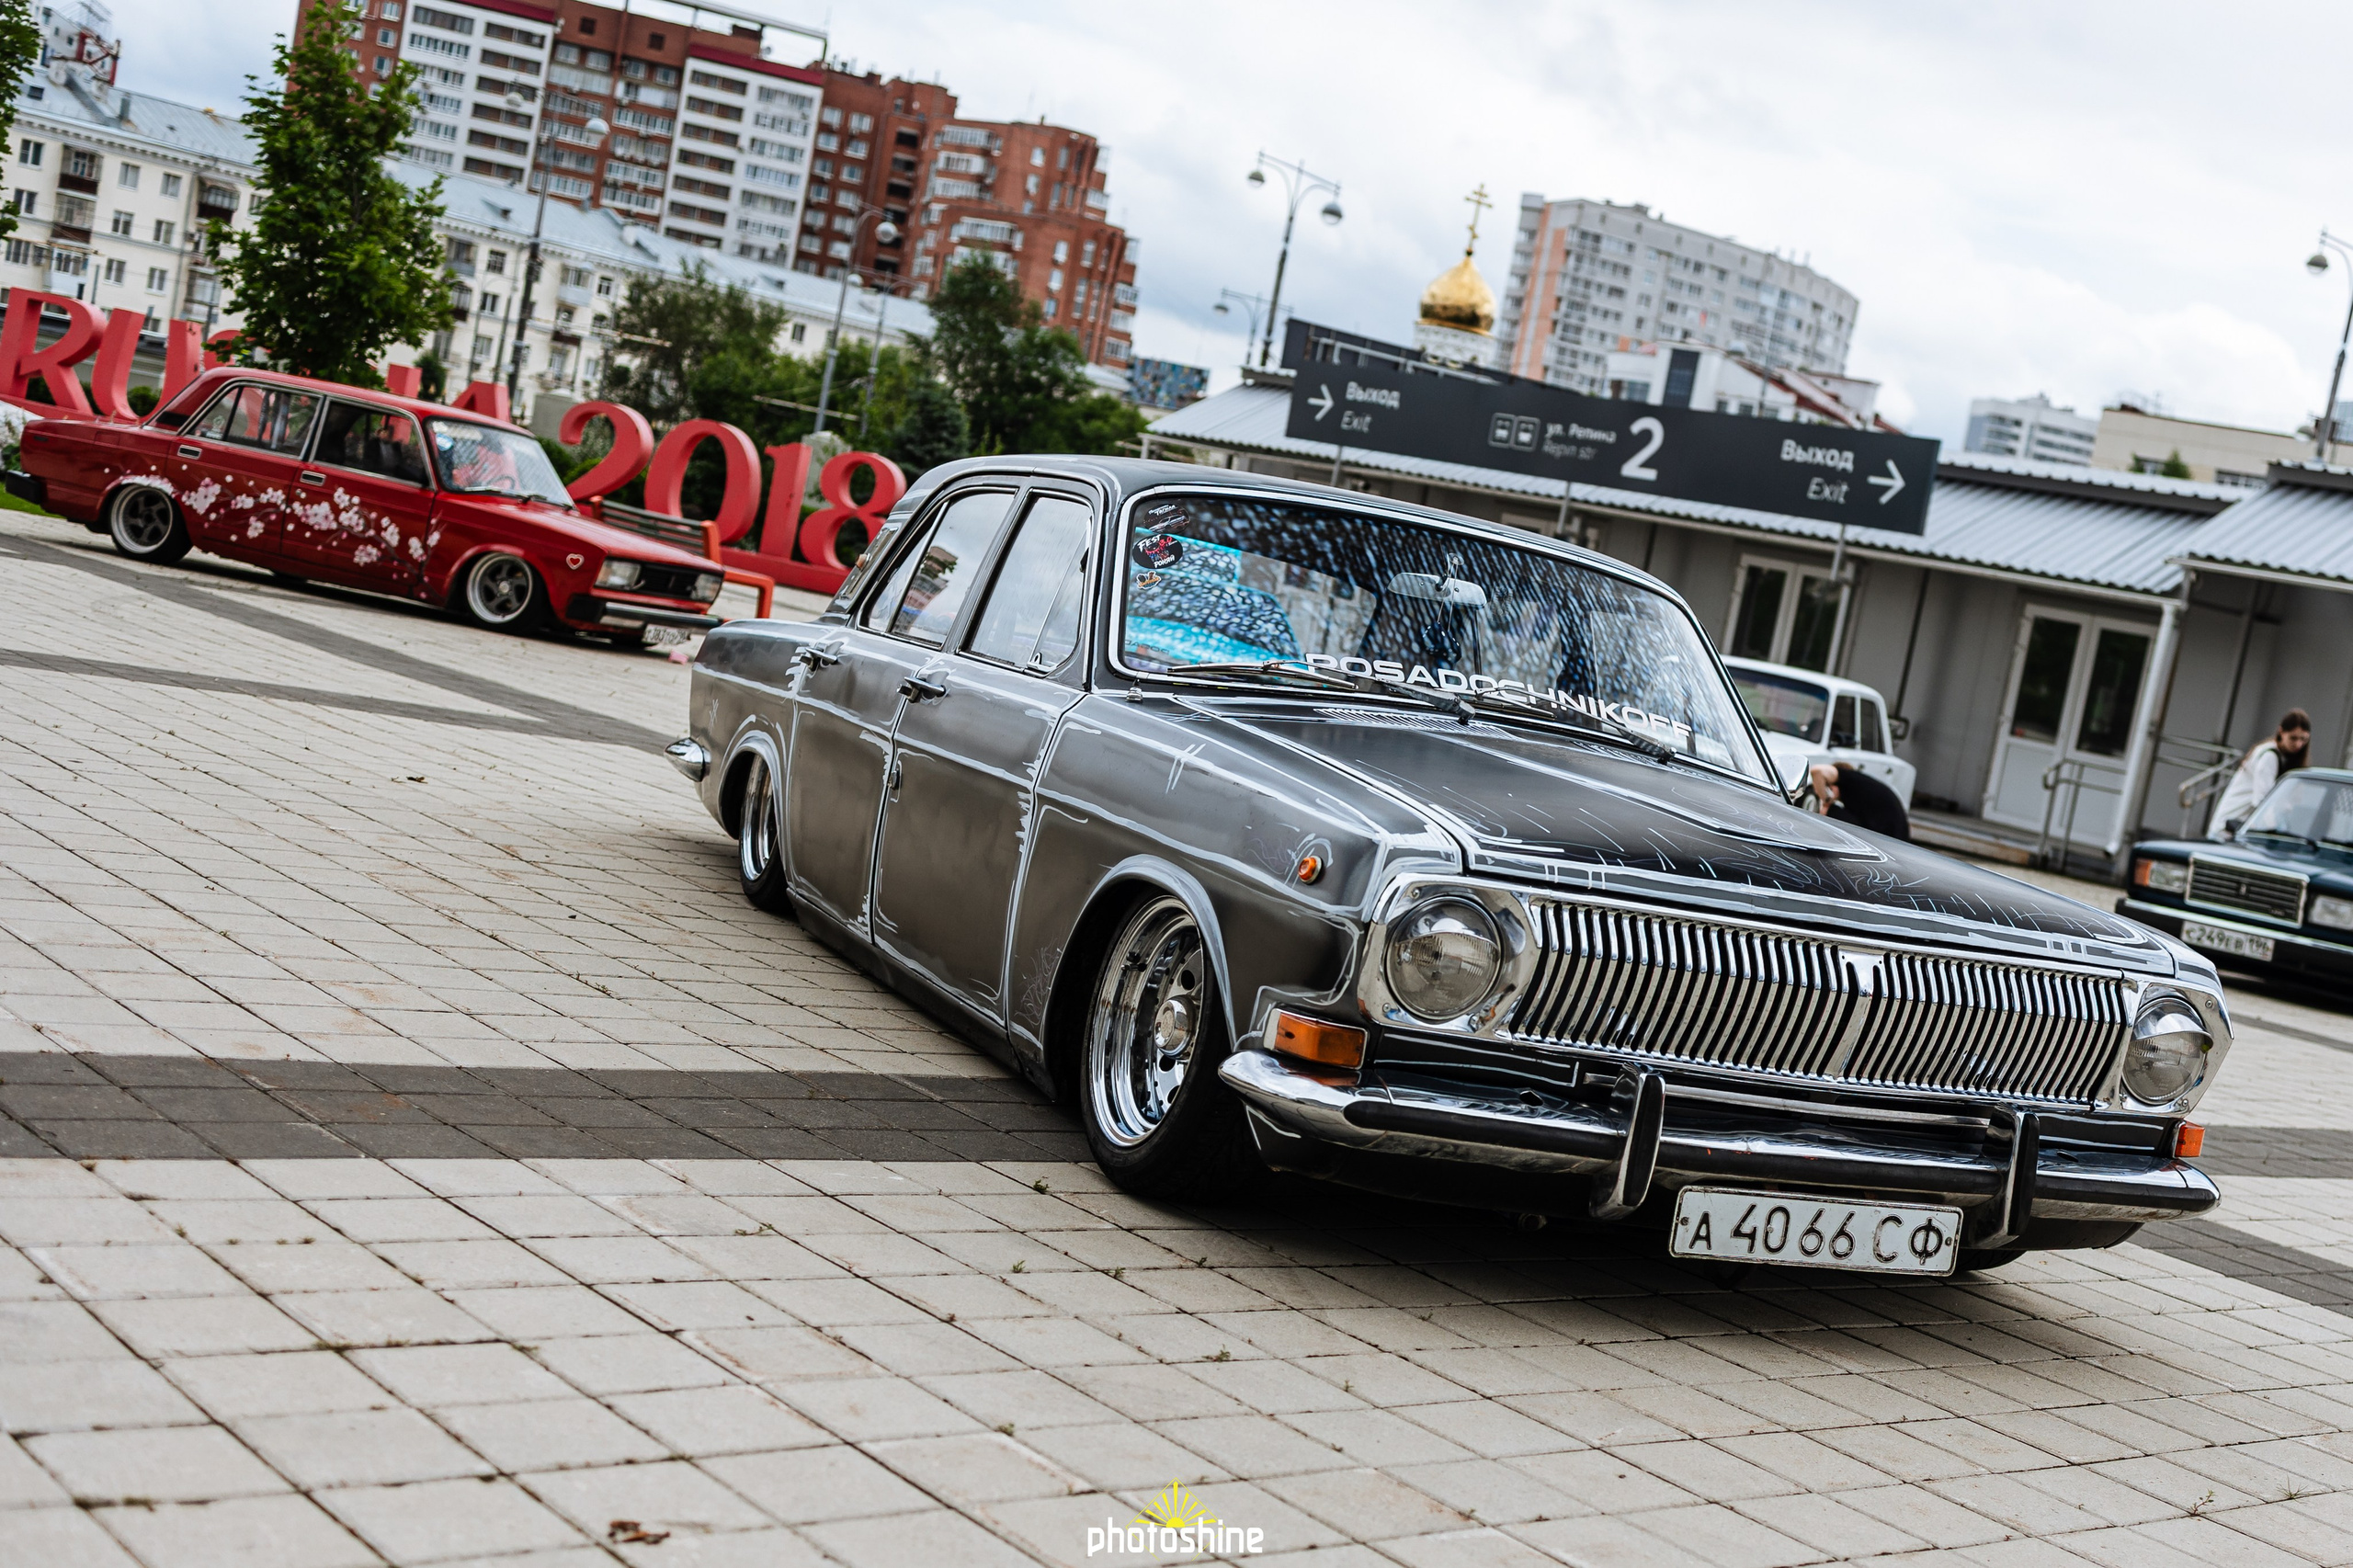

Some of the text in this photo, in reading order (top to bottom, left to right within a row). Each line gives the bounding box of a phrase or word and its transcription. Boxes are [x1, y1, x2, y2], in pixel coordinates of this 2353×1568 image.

[1346, 381, 1401, 409] Выход
[1340, 411, 1372, 433] Exit
[1568, 423, 1618, 444] Репина
[1620, 416, 1665, 481] 2
[1780, 438, 1855, 473] Выход
[559, 401, 907, 570] 2018
[1806, 477, 1849, 505] Exit
[1137, 534, 1162, 552] FEST
[1688, 1202, 1944, 1266] А 4066 СФ
